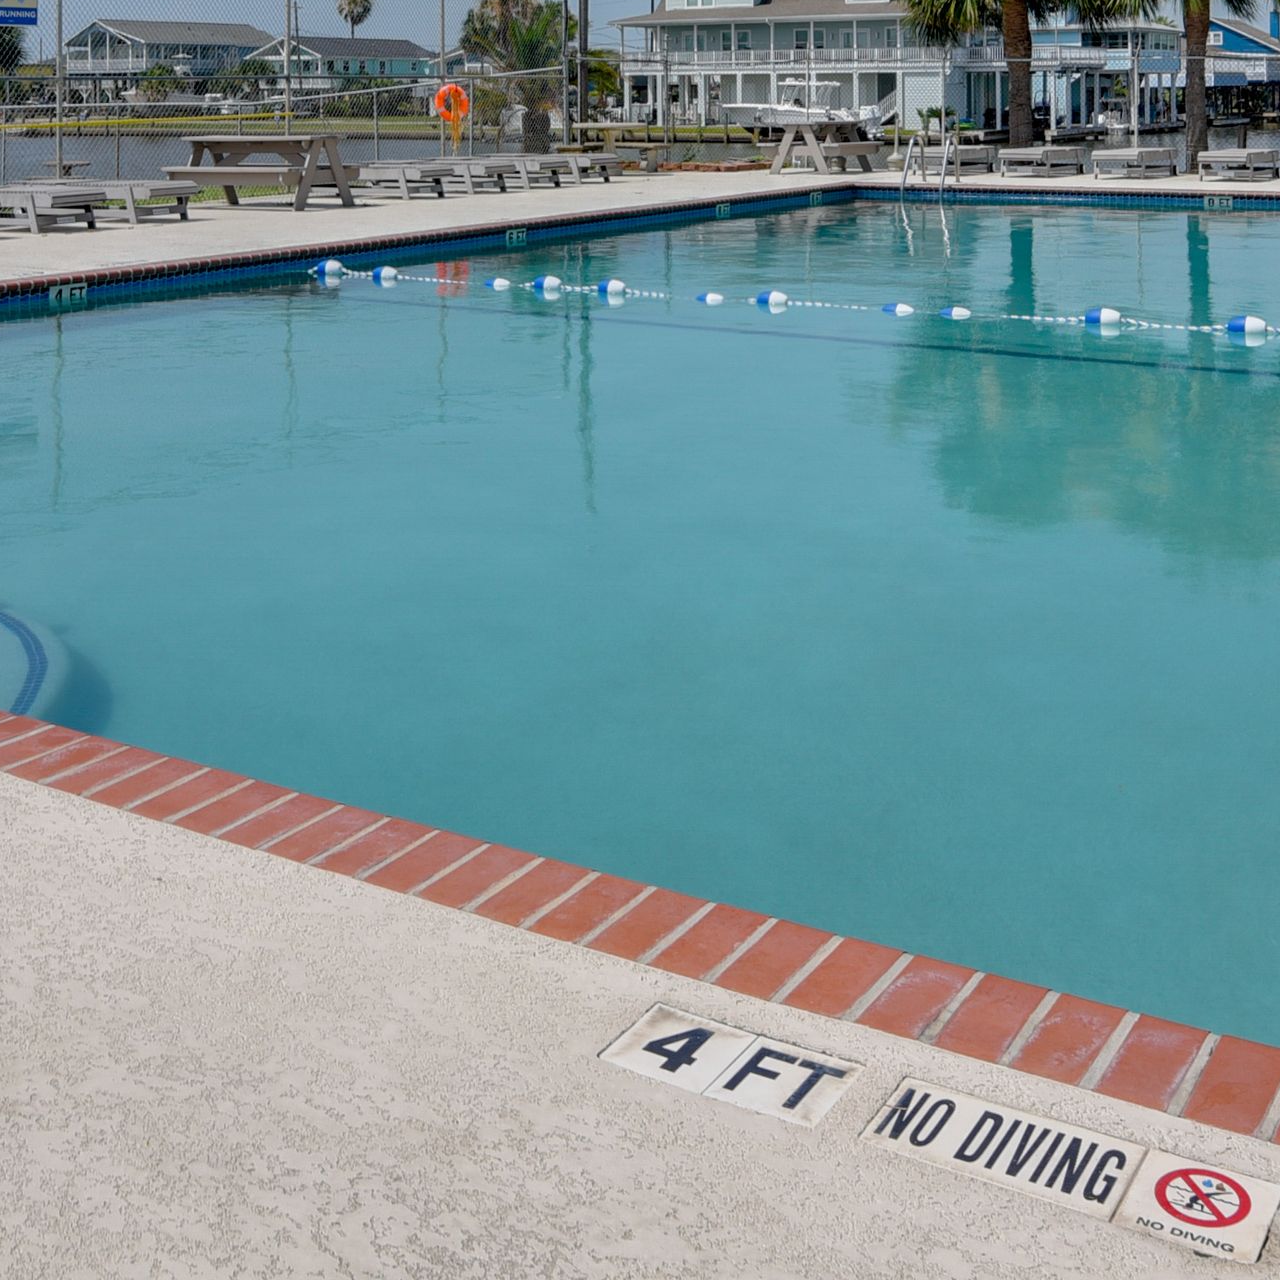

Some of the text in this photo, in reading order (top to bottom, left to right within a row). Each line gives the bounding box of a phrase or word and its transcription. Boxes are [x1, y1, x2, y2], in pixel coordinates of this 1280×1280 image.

[0, 10, 36, 19] RUNNING
[642, 1026, 849, 1111] 4 FT
[874, 1086, 1127, 1206] NO DIVING
[1136, 1216, 1235, 1253] NO DIVING
